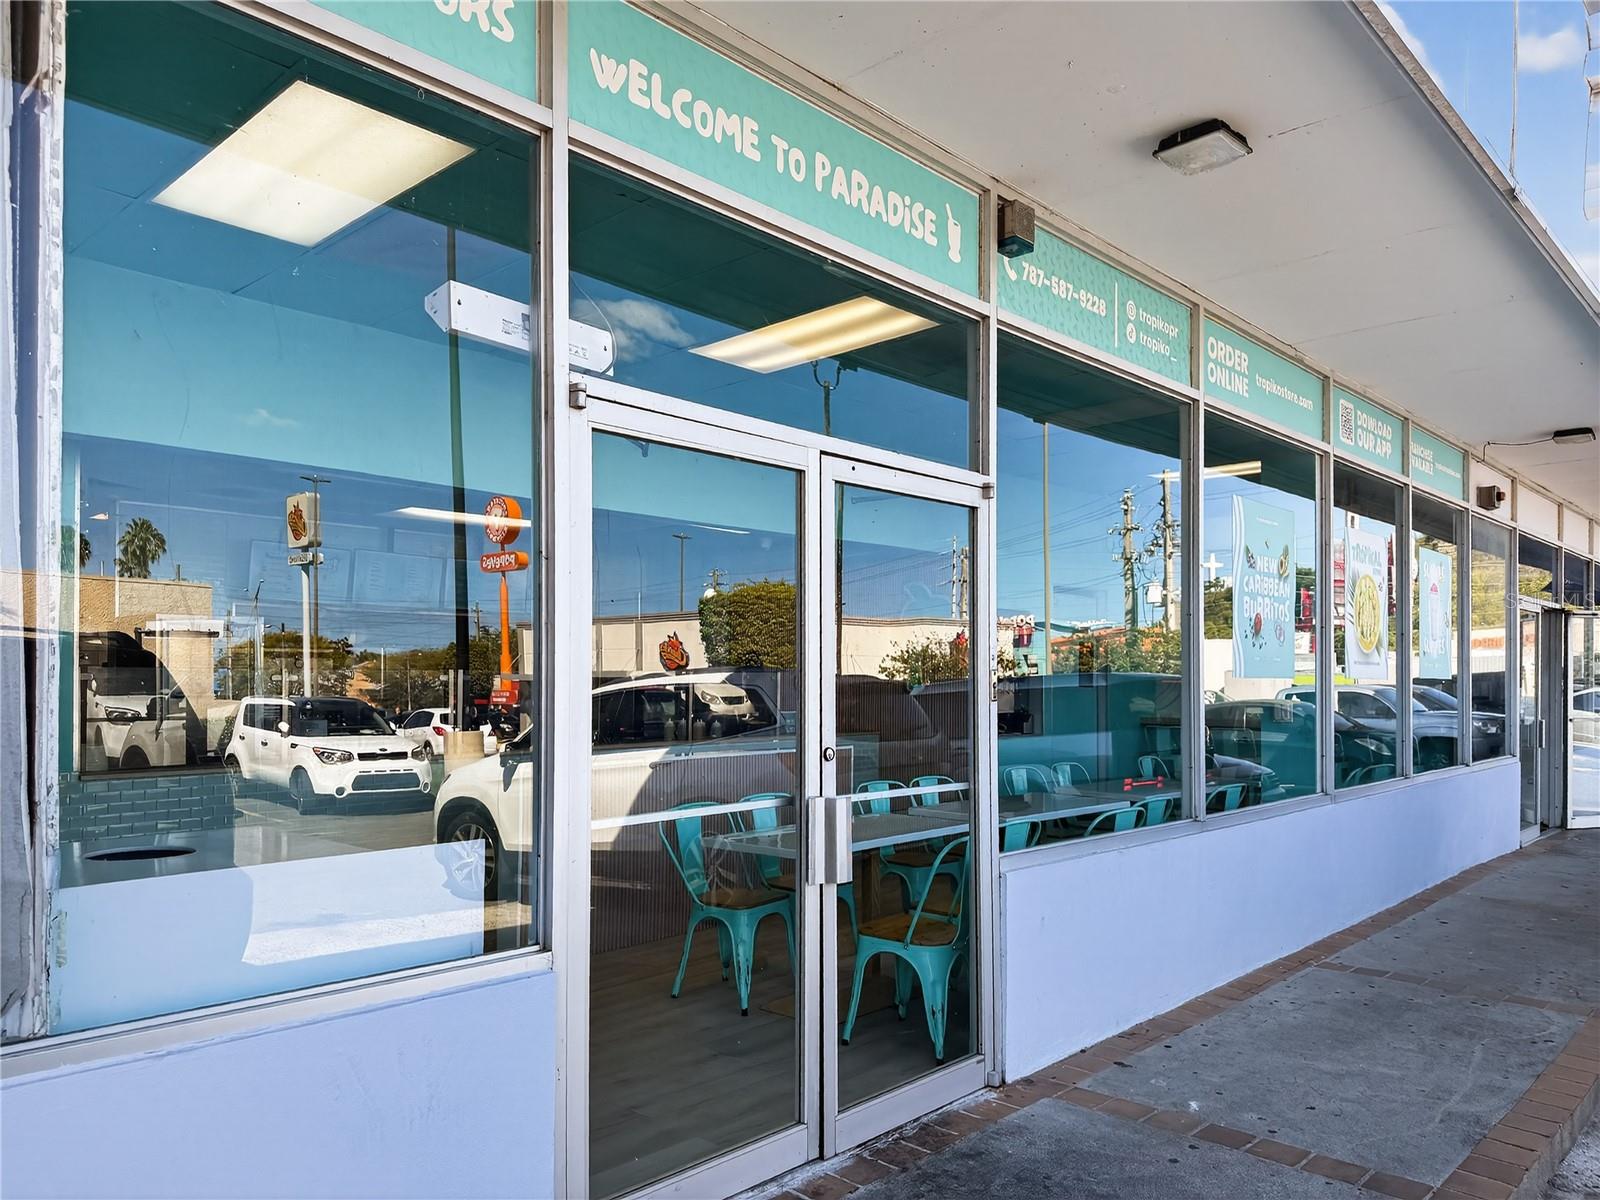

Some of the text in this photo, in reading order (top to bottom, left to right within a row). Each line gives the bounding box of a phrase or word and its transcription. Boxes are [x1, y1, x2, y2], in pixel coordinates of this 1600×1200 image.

[589, 47, 762, 162] WELCOME
[770, 134, 806, 183] TO
[1022, 260, 1108, 318] 787-587-9228
[1207, 336, 1249, 376] ORDER
[1207, 361, 1249, 399] ONLINE
[1356, 428, 1393, 461] OUR APP
[1256, 555, 1279, 574] NEW
